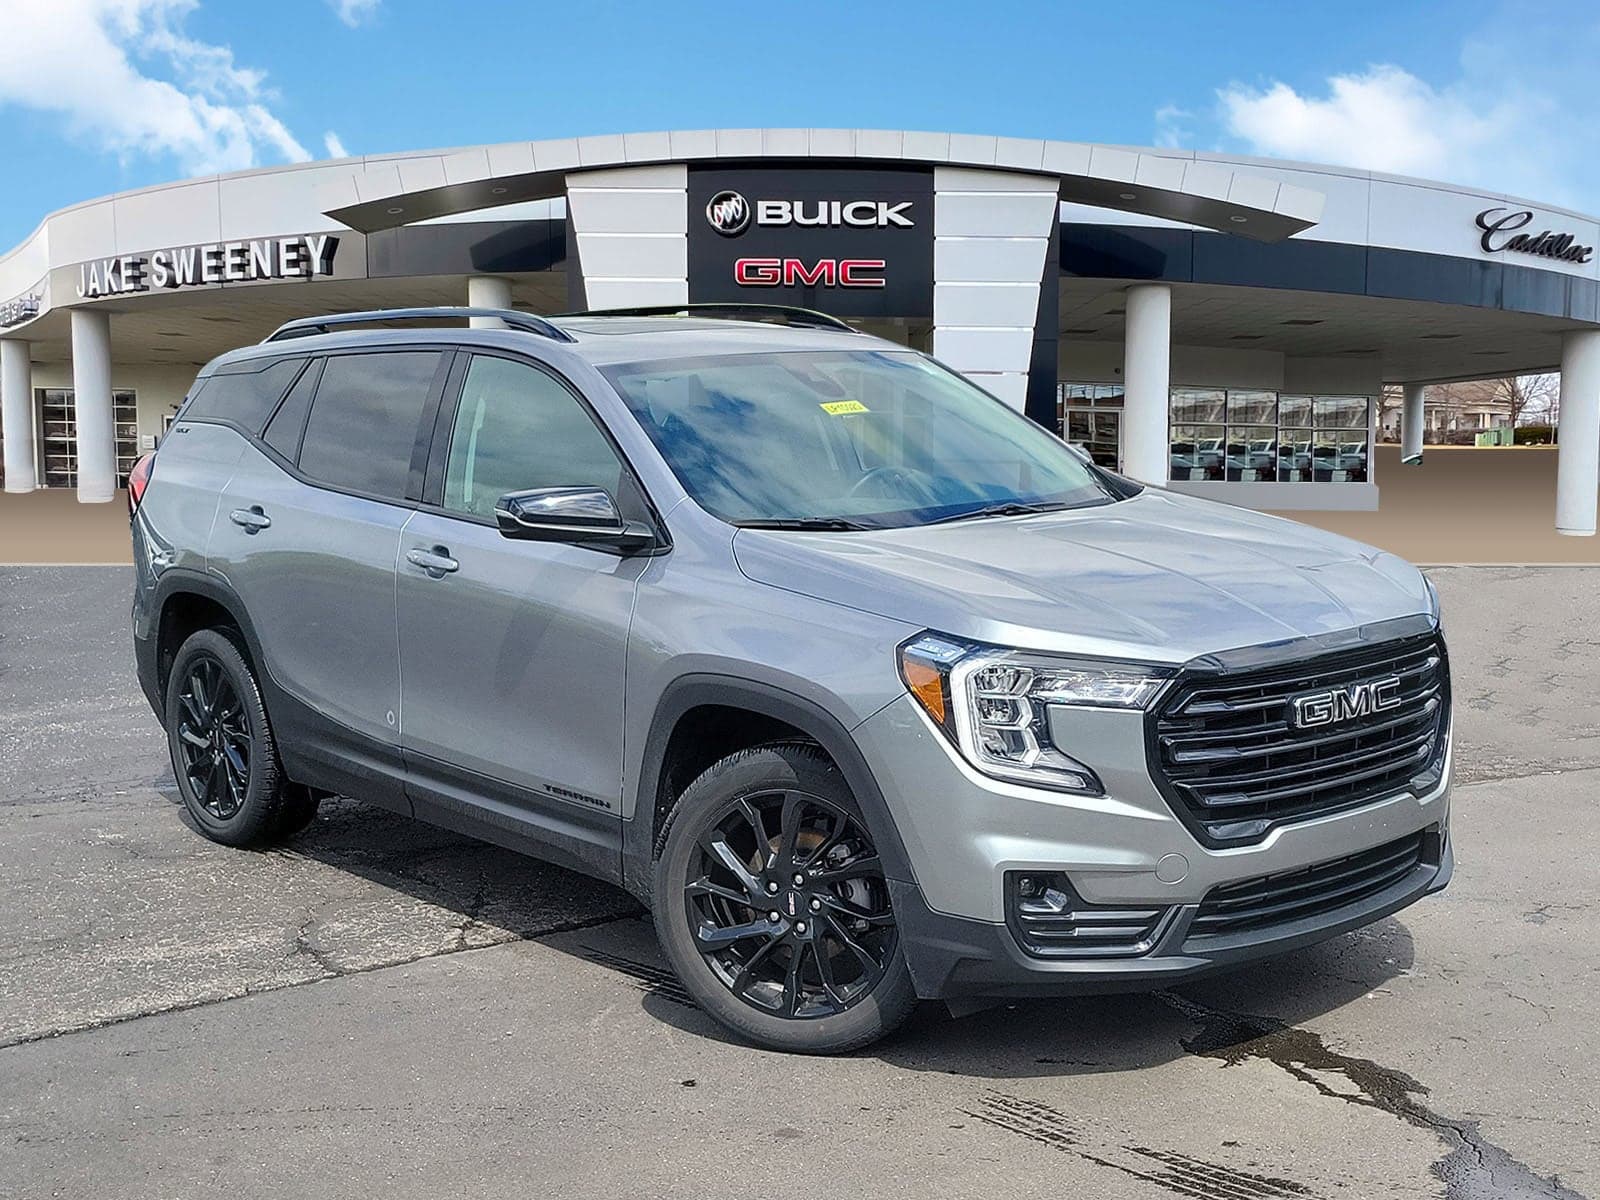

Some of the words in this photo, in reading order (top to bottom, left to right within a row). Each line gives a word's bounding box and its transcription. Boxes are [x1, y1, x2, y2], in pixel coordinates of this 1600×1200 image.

[757, 200, 915, 226] BUICK
[1475, 207, 1593, 263] Cadillac
[76, 256, 140, 298] JAKE
[151, 234, 331, 289] SWEENEY
[734, 258, 886, 287] GMC
[1296, 677, 1401, 729] GMC
[542, 783, 611, 809] TERRAIN
